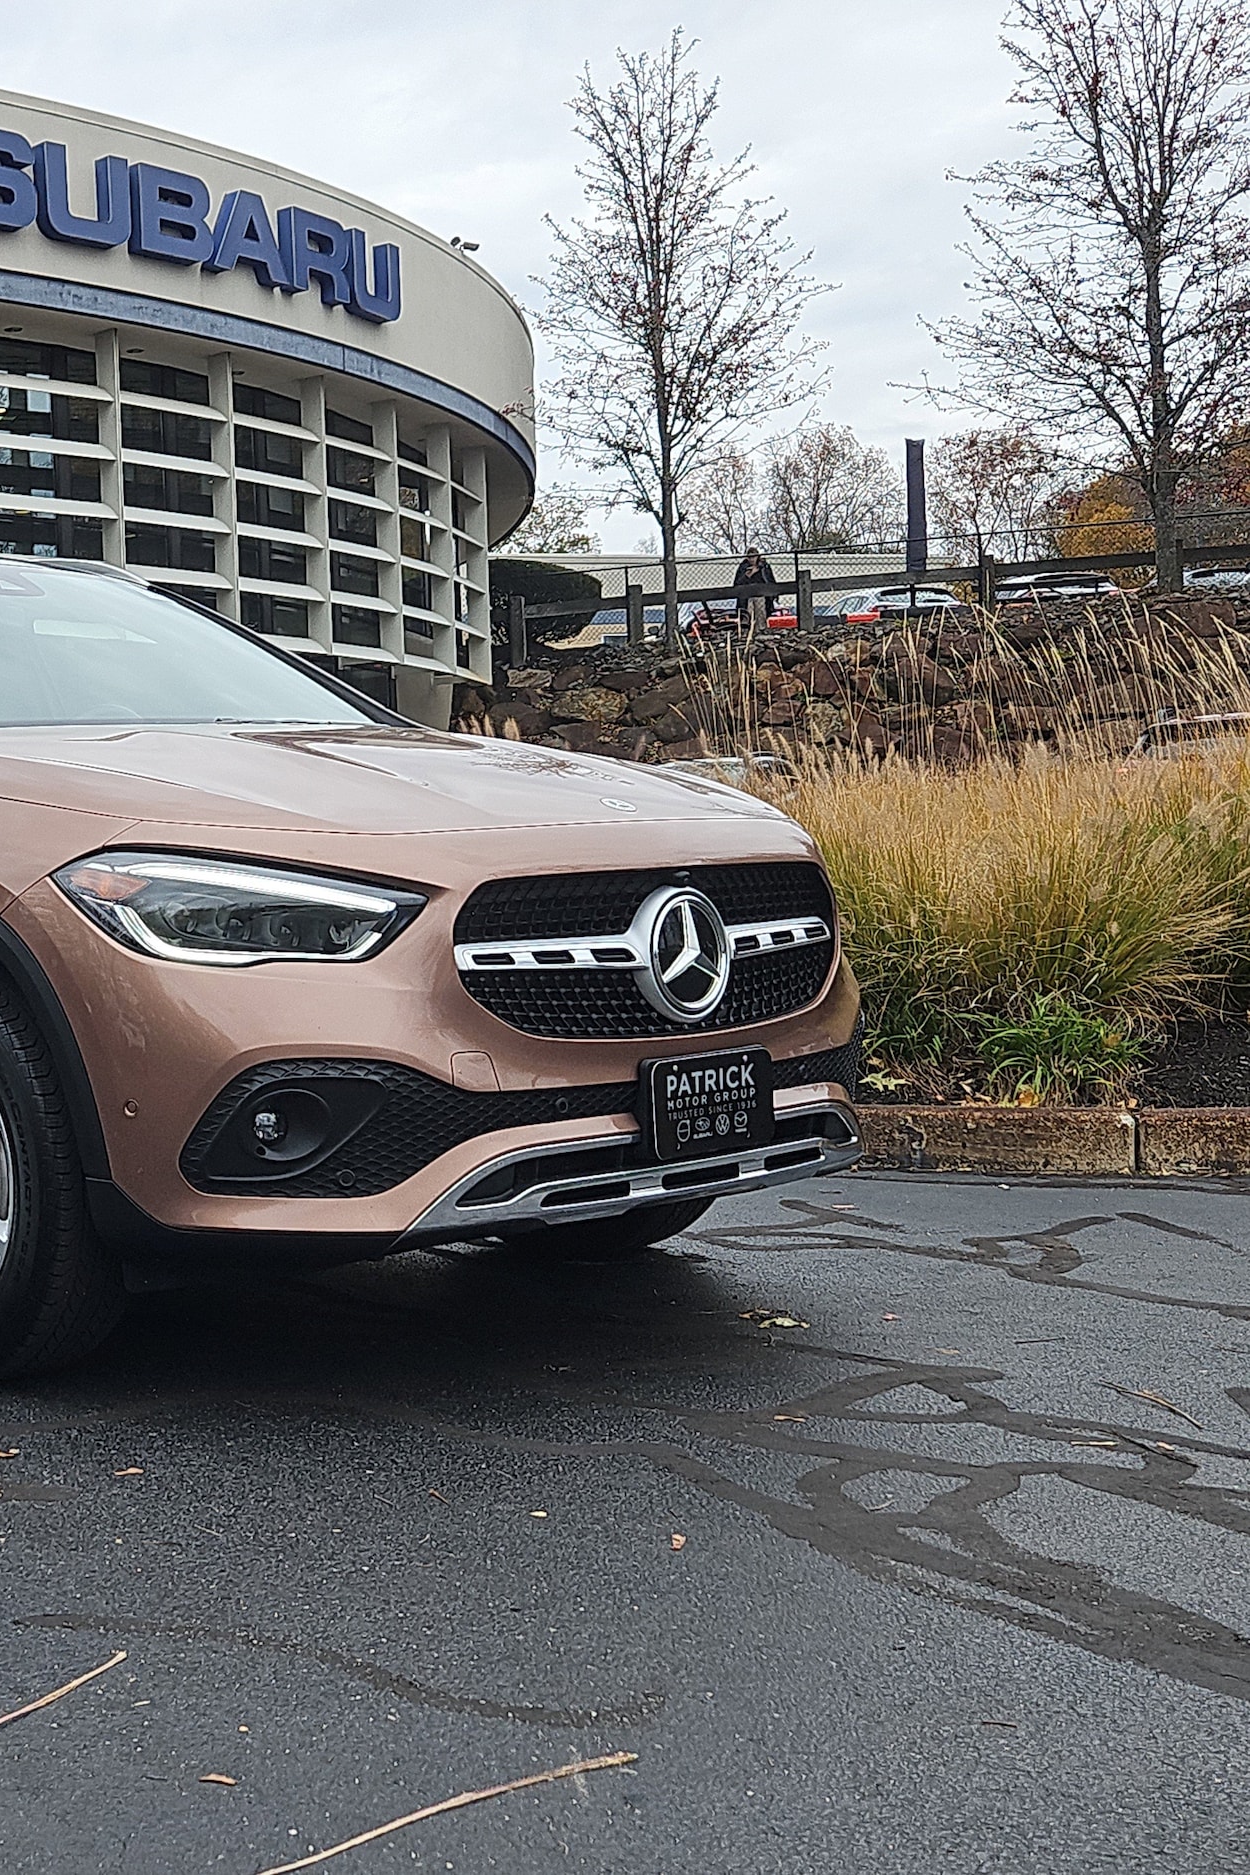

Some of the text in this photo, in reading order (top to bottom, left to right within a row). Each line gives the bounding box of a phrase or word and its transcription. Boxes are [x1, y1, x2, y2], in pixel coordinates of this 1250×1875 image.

[666, 1063, 755, 1098] PATRICK
[667, 1088, 756, 1111] MOTOR GROUP
[668, 1107, 705, 1121] TRUSTED
[708, 1103, 734, 1115] SINCE
